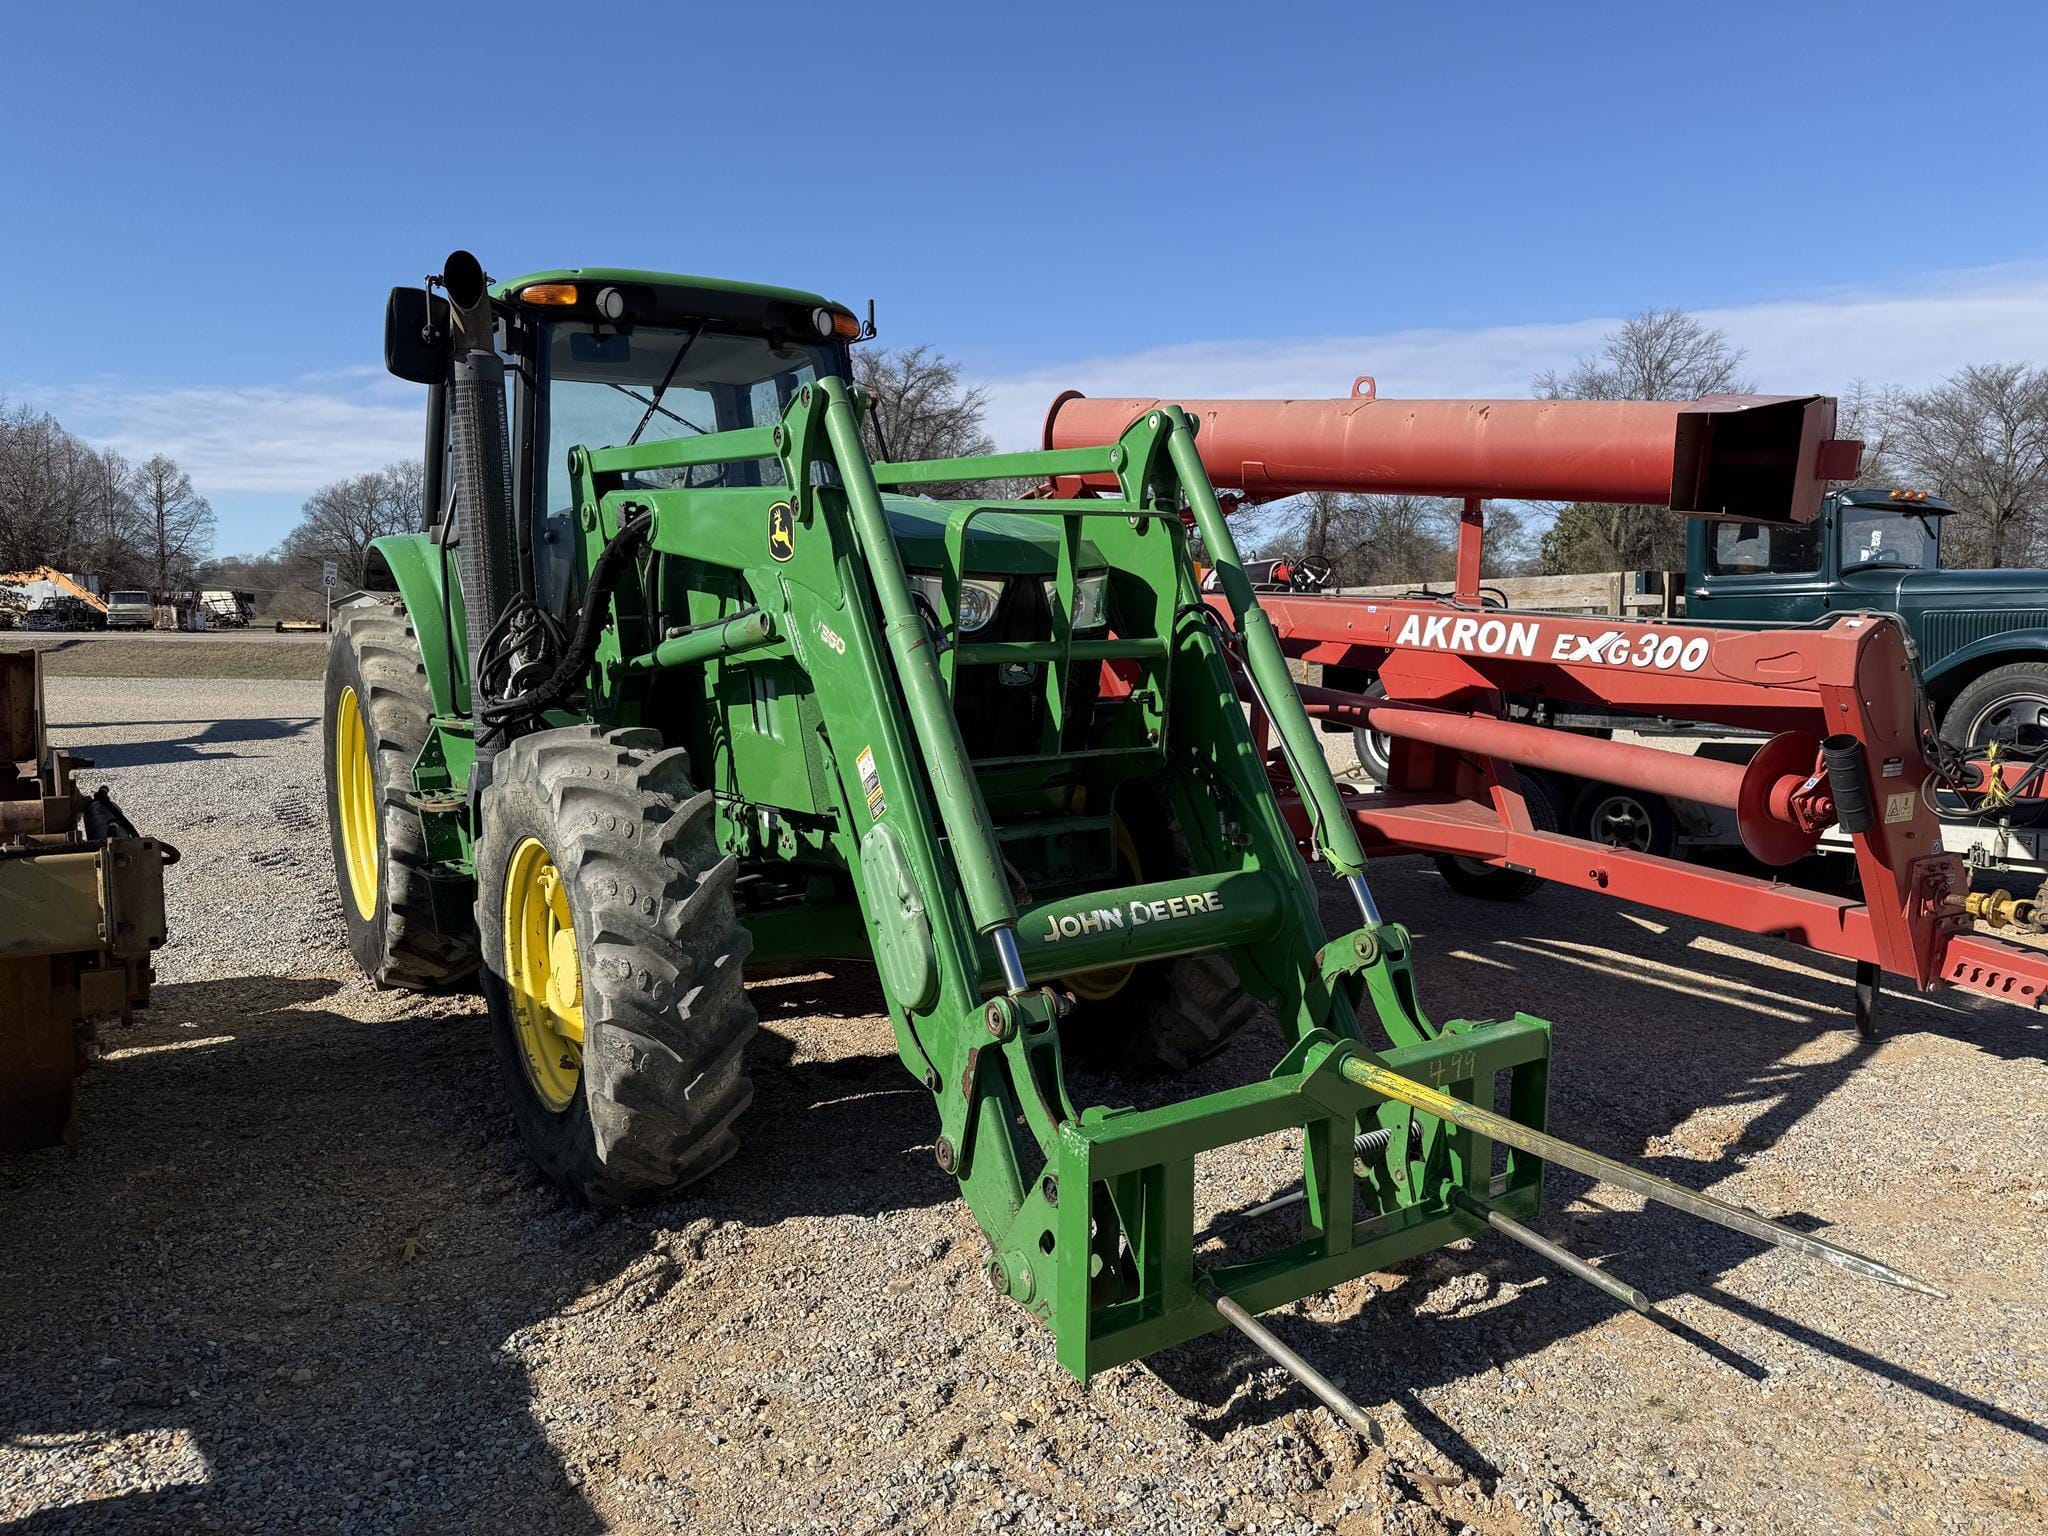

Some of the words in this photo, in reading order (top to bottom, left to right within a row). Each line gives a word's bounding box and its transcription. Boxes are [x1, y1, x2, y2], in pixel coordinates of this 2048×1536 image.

[325, 576, 335, 585] 60
[1395, 614, 1540, 657] AKRON
[1043, 907, 1125, 943] JOHN
[1129, 890, 1225, 927] DEERE
